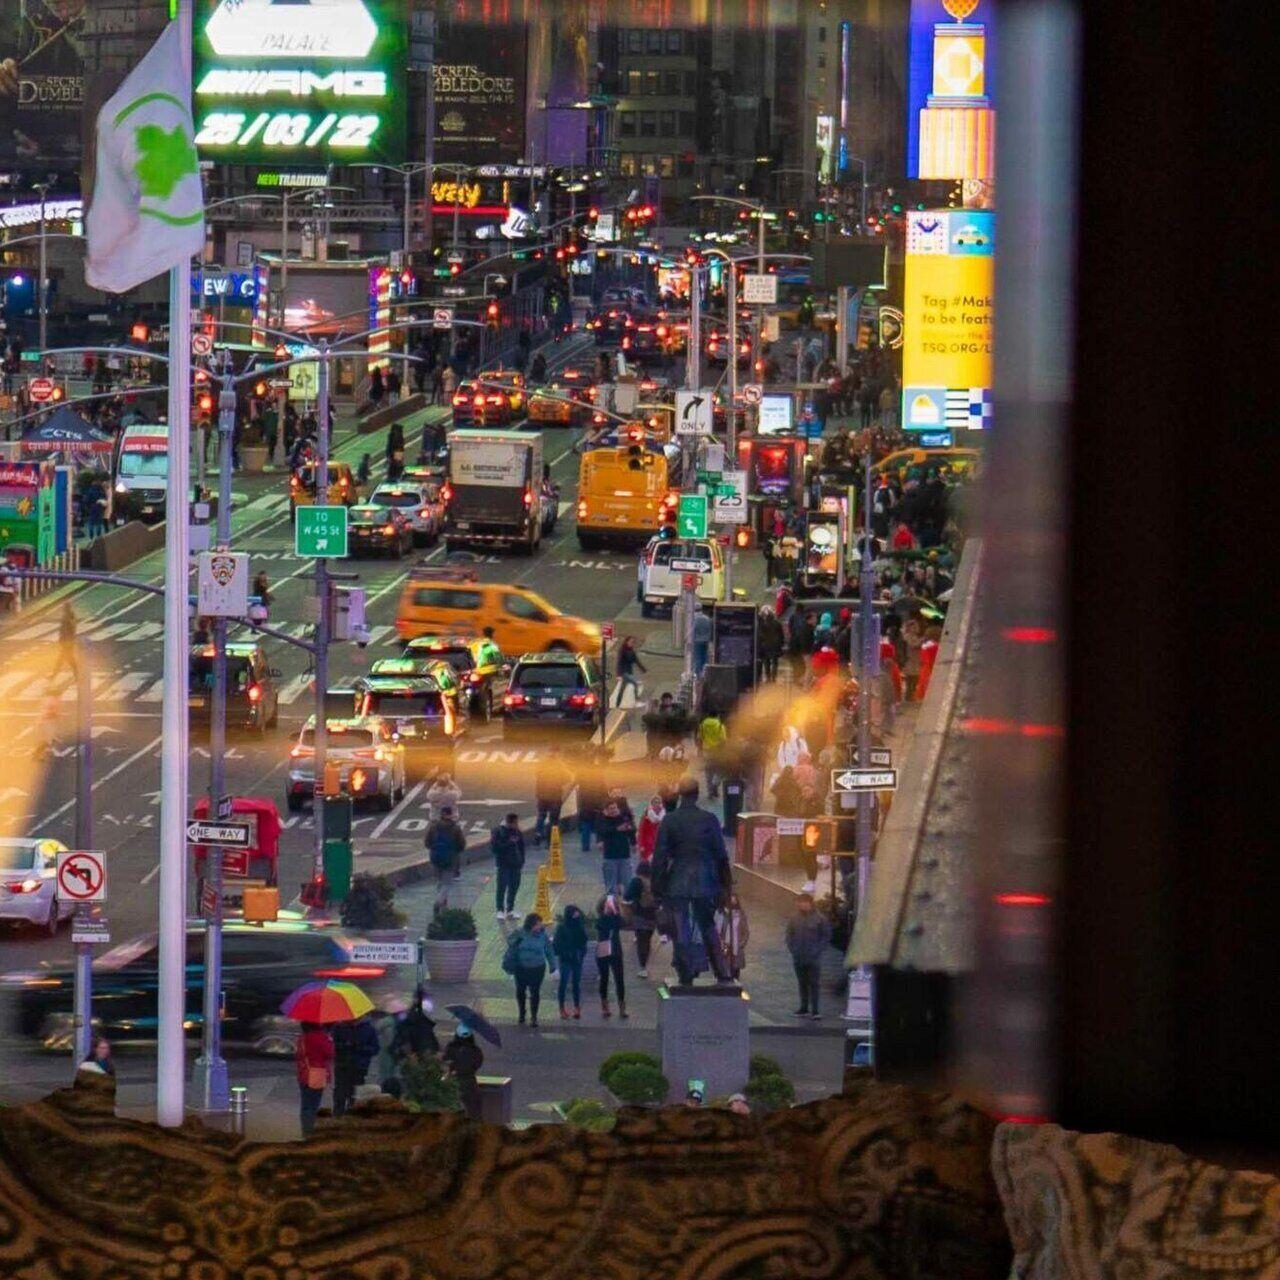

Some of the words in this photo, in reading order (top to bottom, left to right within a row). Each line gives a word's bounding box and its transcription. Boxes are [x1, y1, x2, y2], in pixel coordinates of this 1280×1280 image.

[922, 295, 947, 310] Tag
[681, 423, 705, 431] ONLY
[315, 512, 329, 522] TO
[313, 526, 328, 535] 45
[329, 526, 340, 536] St
[190, 828, 210, 838] ONE
[219, 829, 241, 839] WAY
